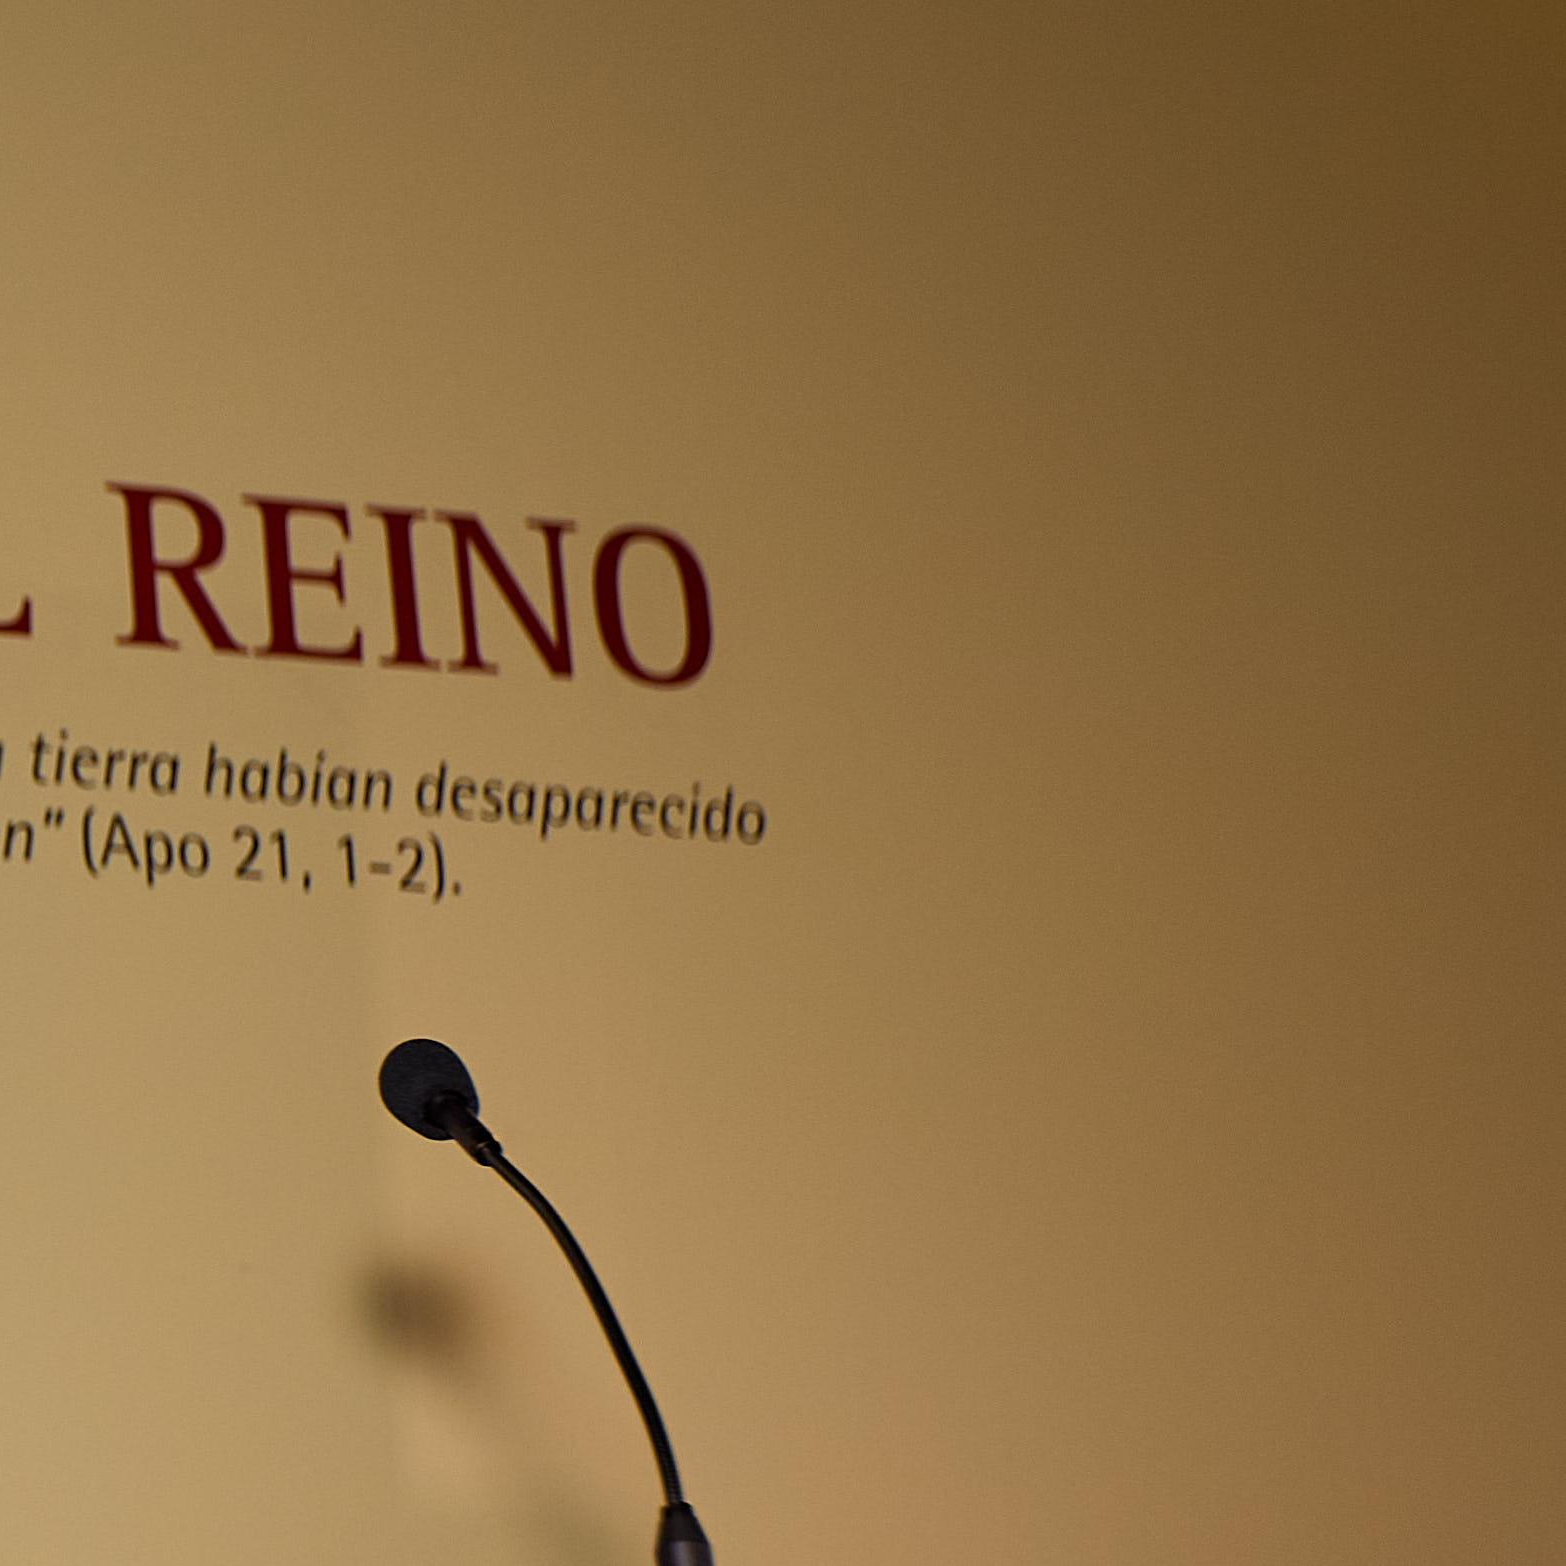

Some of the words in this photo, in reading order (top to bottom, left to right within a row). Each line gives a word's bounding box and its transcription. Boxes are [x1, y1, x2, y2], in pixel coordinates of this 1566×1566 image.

[105, 479, 715, 692] REINO
[30, 727, 181, 797] tierra
[414, 758, 767, 847] desaparecido
[80, 803, 212, 889] (Apo
[231, 823, 313, 895] 21,
